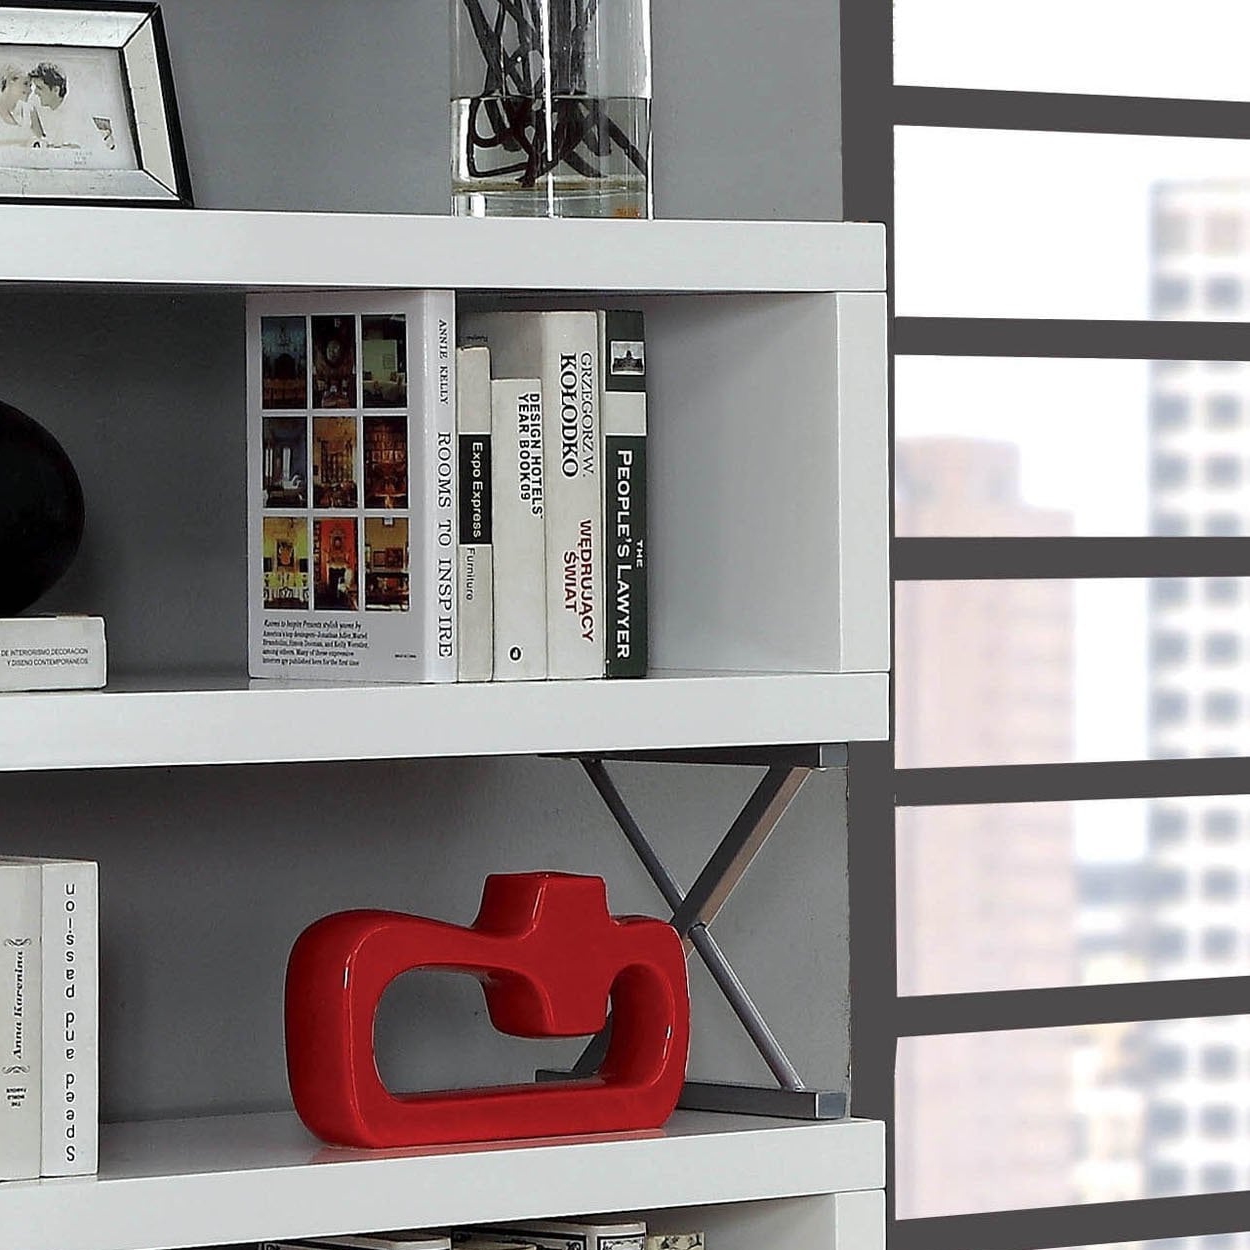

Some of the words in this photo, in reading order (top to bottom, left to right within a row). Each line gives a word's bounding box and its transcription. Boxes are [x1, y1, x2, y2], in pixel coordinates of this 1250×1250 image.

[438, 319, 448, 359] ANNIE
[439, 366, 449, 405] KELLY
[518, 393, 530, 433] YEAR
[581, 352, 594, 453] GRZEGORZ
[530, 393, 541, 449] DESIGN
[438, 432, 452, 508] ROOMS
[470, 442, 483, 478] Expo
[470, 481, 484, 538] Express
[617, 450, 633, 558] PEOPLE'S
[438, 519, 452, 547] TO
[636, 539, 644, 568] THE
[438, 558, 453, 658] INSPIRE
[563, 551, 579, 612] ŚWIAT
[617, 564, 632, 659] LAWYER
[13, 1022, 22, 1059] Anna
